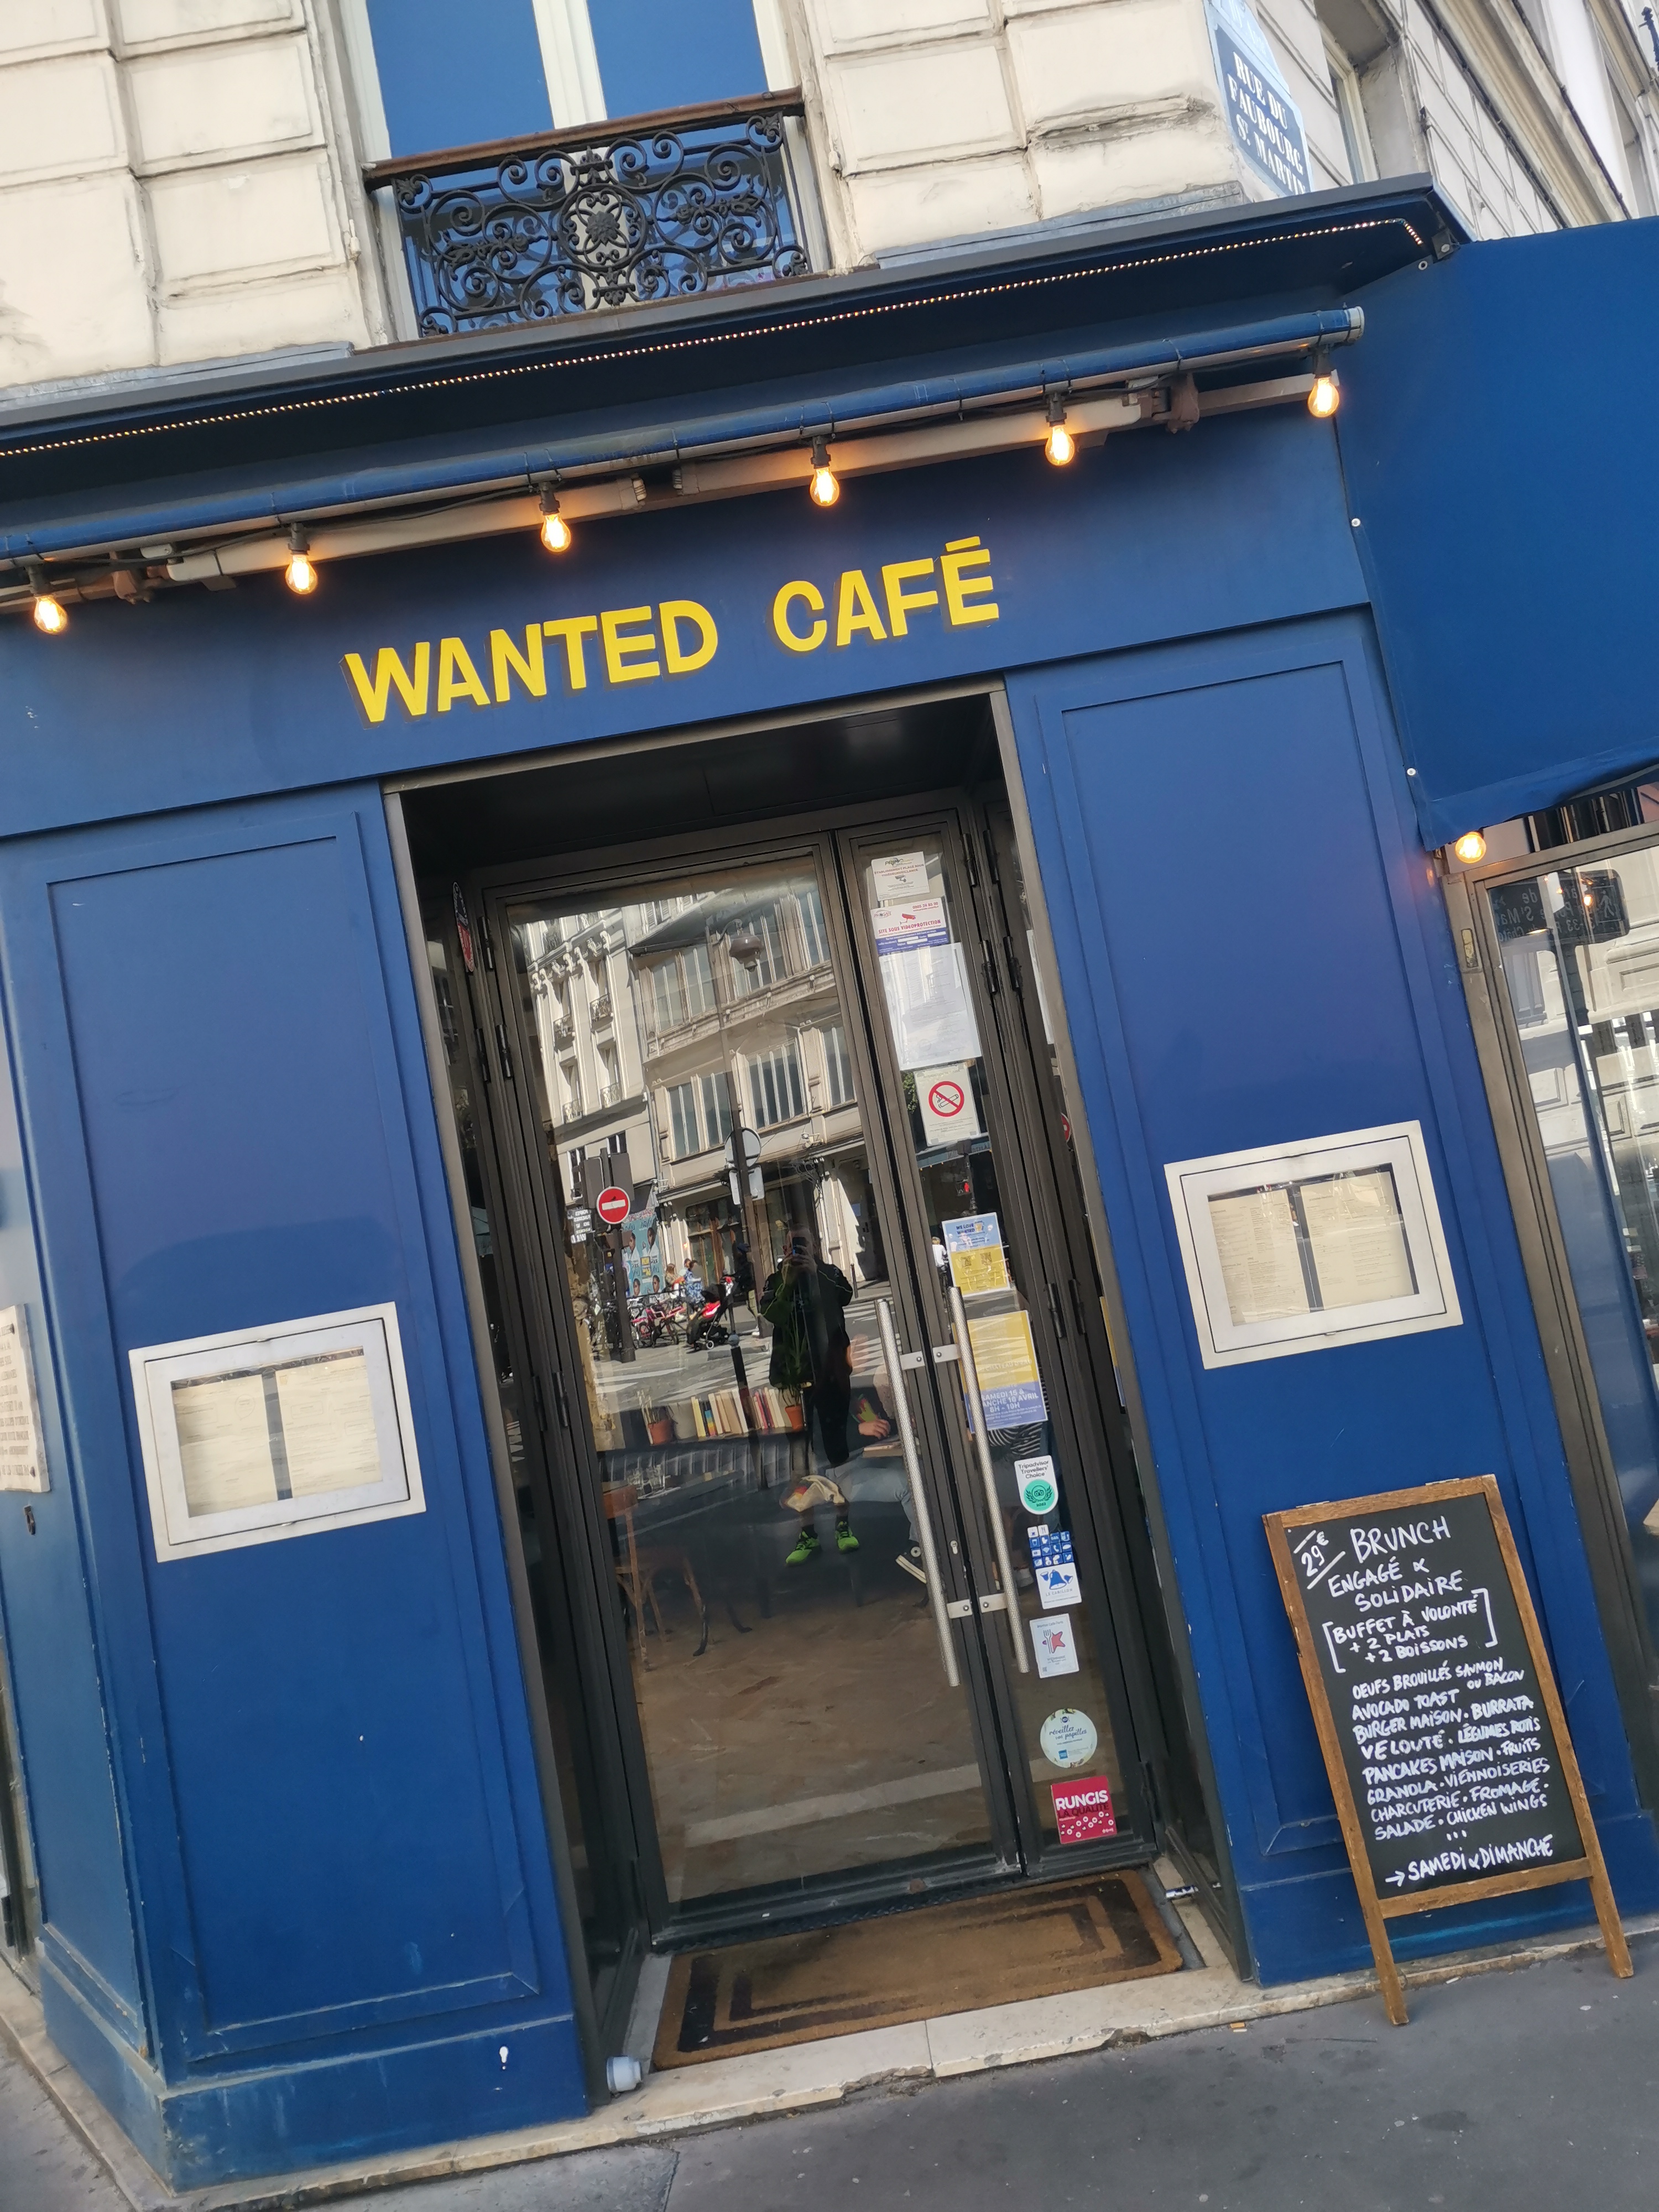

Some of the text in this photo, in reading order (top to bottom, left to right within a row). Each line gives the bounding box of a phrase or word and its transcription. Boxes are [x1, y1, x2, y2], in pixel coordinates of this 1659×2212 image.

[1233, 51, 1266, 106] RUE
[1267, 90, 1288, 130] DU
[1227, 74, 1303, 175] FAUBOURG
[1255, 131, 1307, 195] MARTIN
[345, 536, 1000, 723] WANTED CAFÉ
[982, 1397, 1006, 1407] ANCHE
[1017, 1392, 1039, 1401] AVRIL
[1018, 1460, 1049, 1469] Tripadvisor
[1350, 1515, 1452, 1563] BRUNCH
[1328, 1556, 1400, 1598] ENGAGÉ
[1333, 1617, 1394, 1644] BUFFET
[1422, 1594, 1478, 1622] VOLONTÉ
[1367, 1637, 1381, 1650] 2
[1385, 1627, 1430, 1645] PLATS
[1380, 1648, 1392, 1662] 2
[1352, 1678, 1390, 1700] OEUFS
[1455, 1657, 1503, 1678] SAUMON
[1485, 1670, 1525, 1688] BACON
[1352, 1689, 1460, 1721] AVOCADO TOAST
[1353, 1720, 1406, 1744] BURGER
[1471, 1694, 1535, 1721] BURRATA
[1063, 1727, 1087, 1740] papilles
[1458, 1723, 1509, 1744] LÉGUMES
[1363, 1757, 1437, 1785] PANCAKES
[1055, 1789, 1109, 1811] RUNGIS
[1367, 1780, 1437, 1806] GRANOLA
[1470, 1777, 1541, 1802] FROMAGE
[1057, 1809, 1070, 1818] LA
[1374, 1814, 1436, 1841] SALADE
